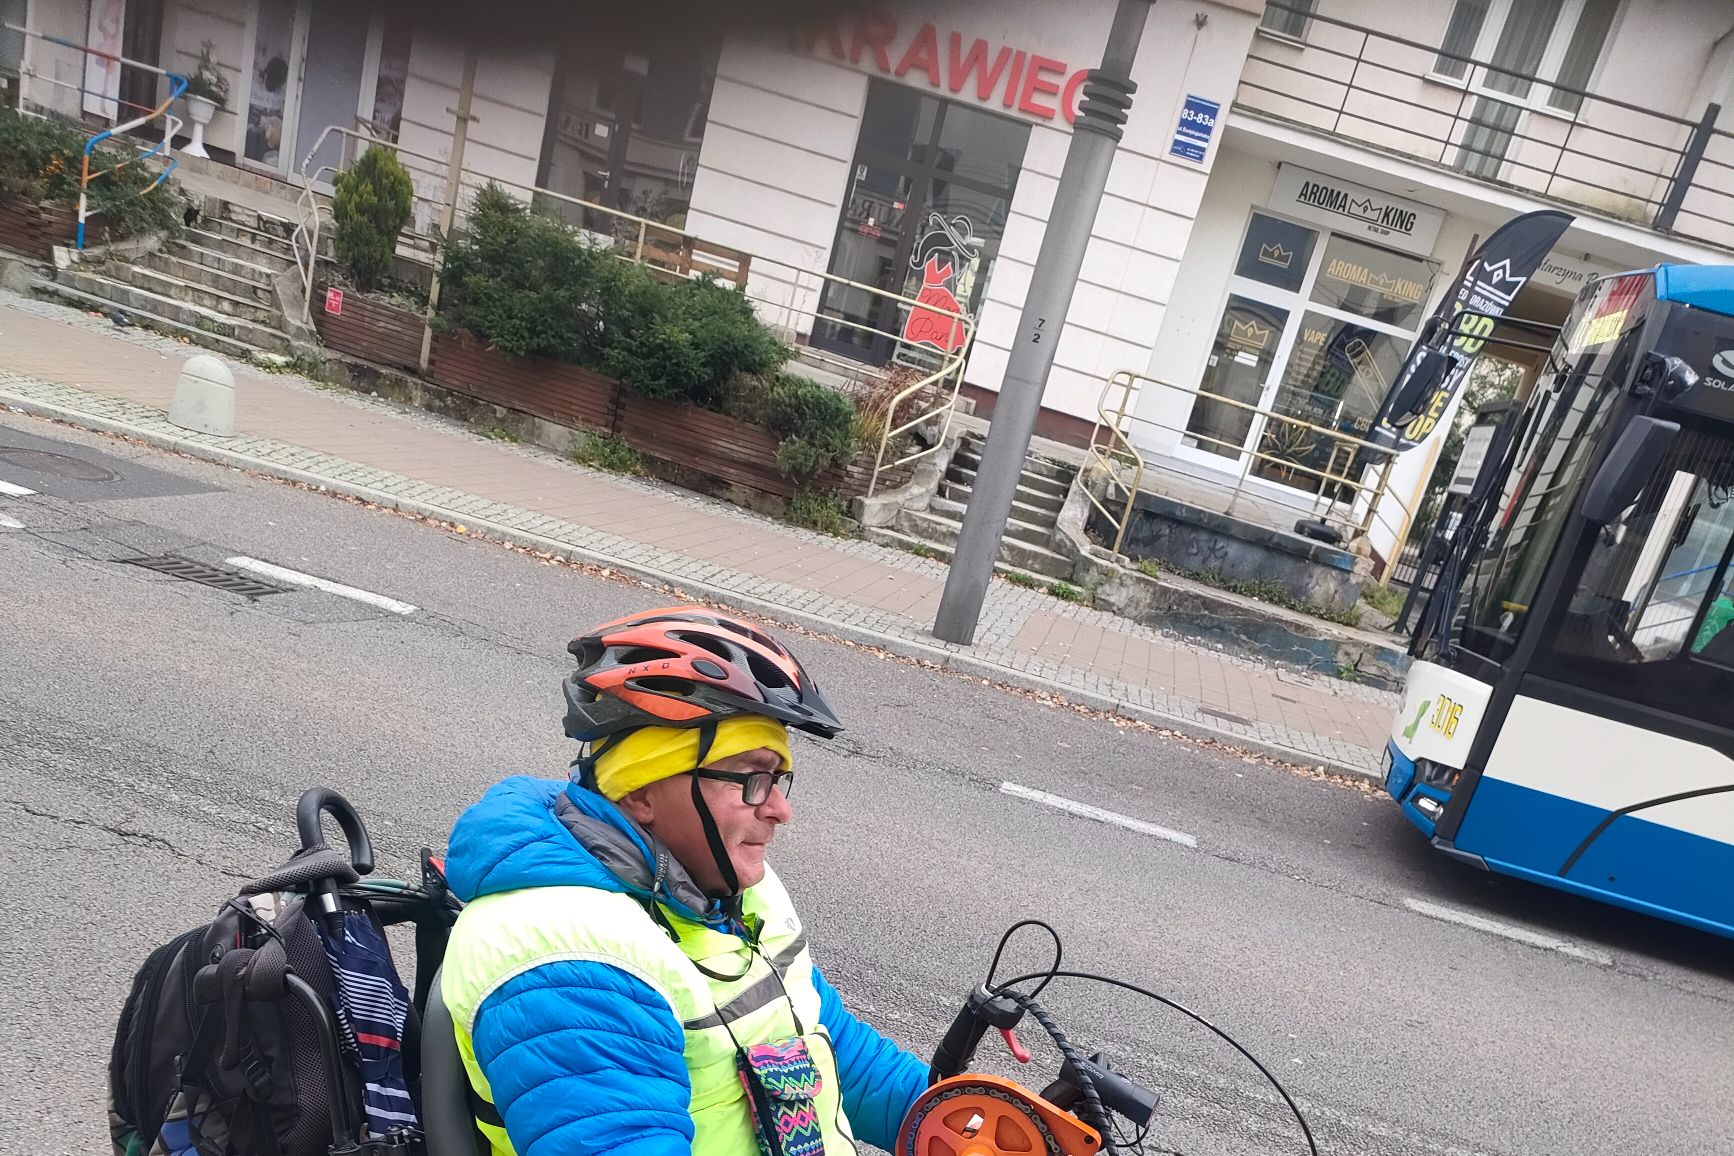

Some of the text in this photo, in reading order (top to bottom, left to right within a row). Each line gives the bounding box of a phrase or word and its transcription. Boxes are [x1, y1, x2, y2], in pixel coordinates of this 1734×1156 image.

[1181, 108, 1215, 127] 83-83a
[1298, 181, 1417, 232] AROMA KING
[1326, 259, 1369, 285] AROMA
[1394, 279, 1423, 300] KING
[1536, 258, 1584, 285] tarzyna
[1038, 318, 1046, 328] 7
[1032, 333, 1041, 344] 2
[1304, 328, 1328, 346] VAPE
[1429, 693, 1464, 741] 3016
